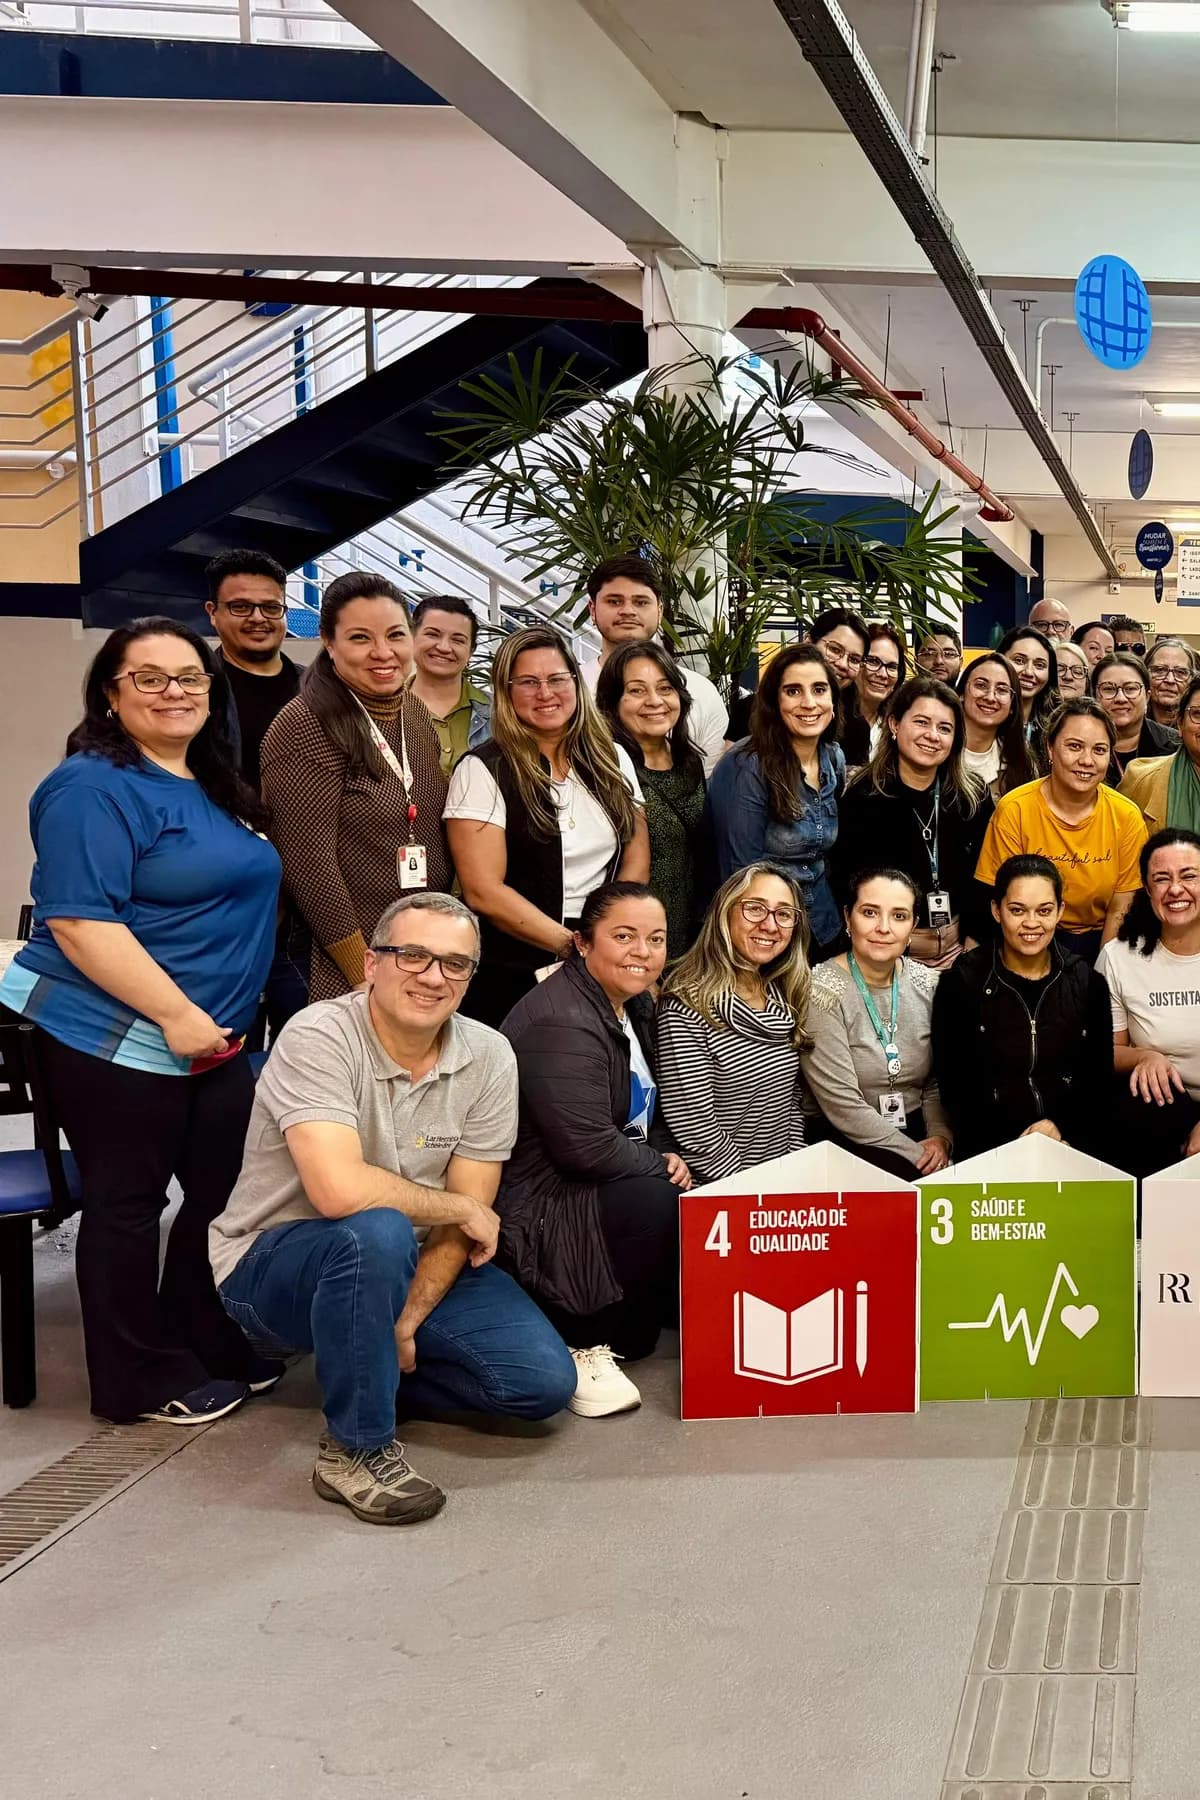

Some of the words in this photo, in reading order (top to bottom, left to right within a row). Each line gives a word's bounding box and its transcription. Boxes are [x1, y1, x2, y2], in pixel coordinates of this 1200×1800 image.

[971, 1197, 1016, 1217] SAÚDE
[1017, 1199, 1026, 1216] E
[749, 1207, 827, 1230] EDUCAÇÃO
[829, 1208, 848, 1227] DE
[930, 1198, 953, 1245] 3
[704, 1210, 732, 1258] 4
[971, 1222, 1046, 1241] BEM-ESTAR
[749, 1233, 830, 1254] QUALIDADE
